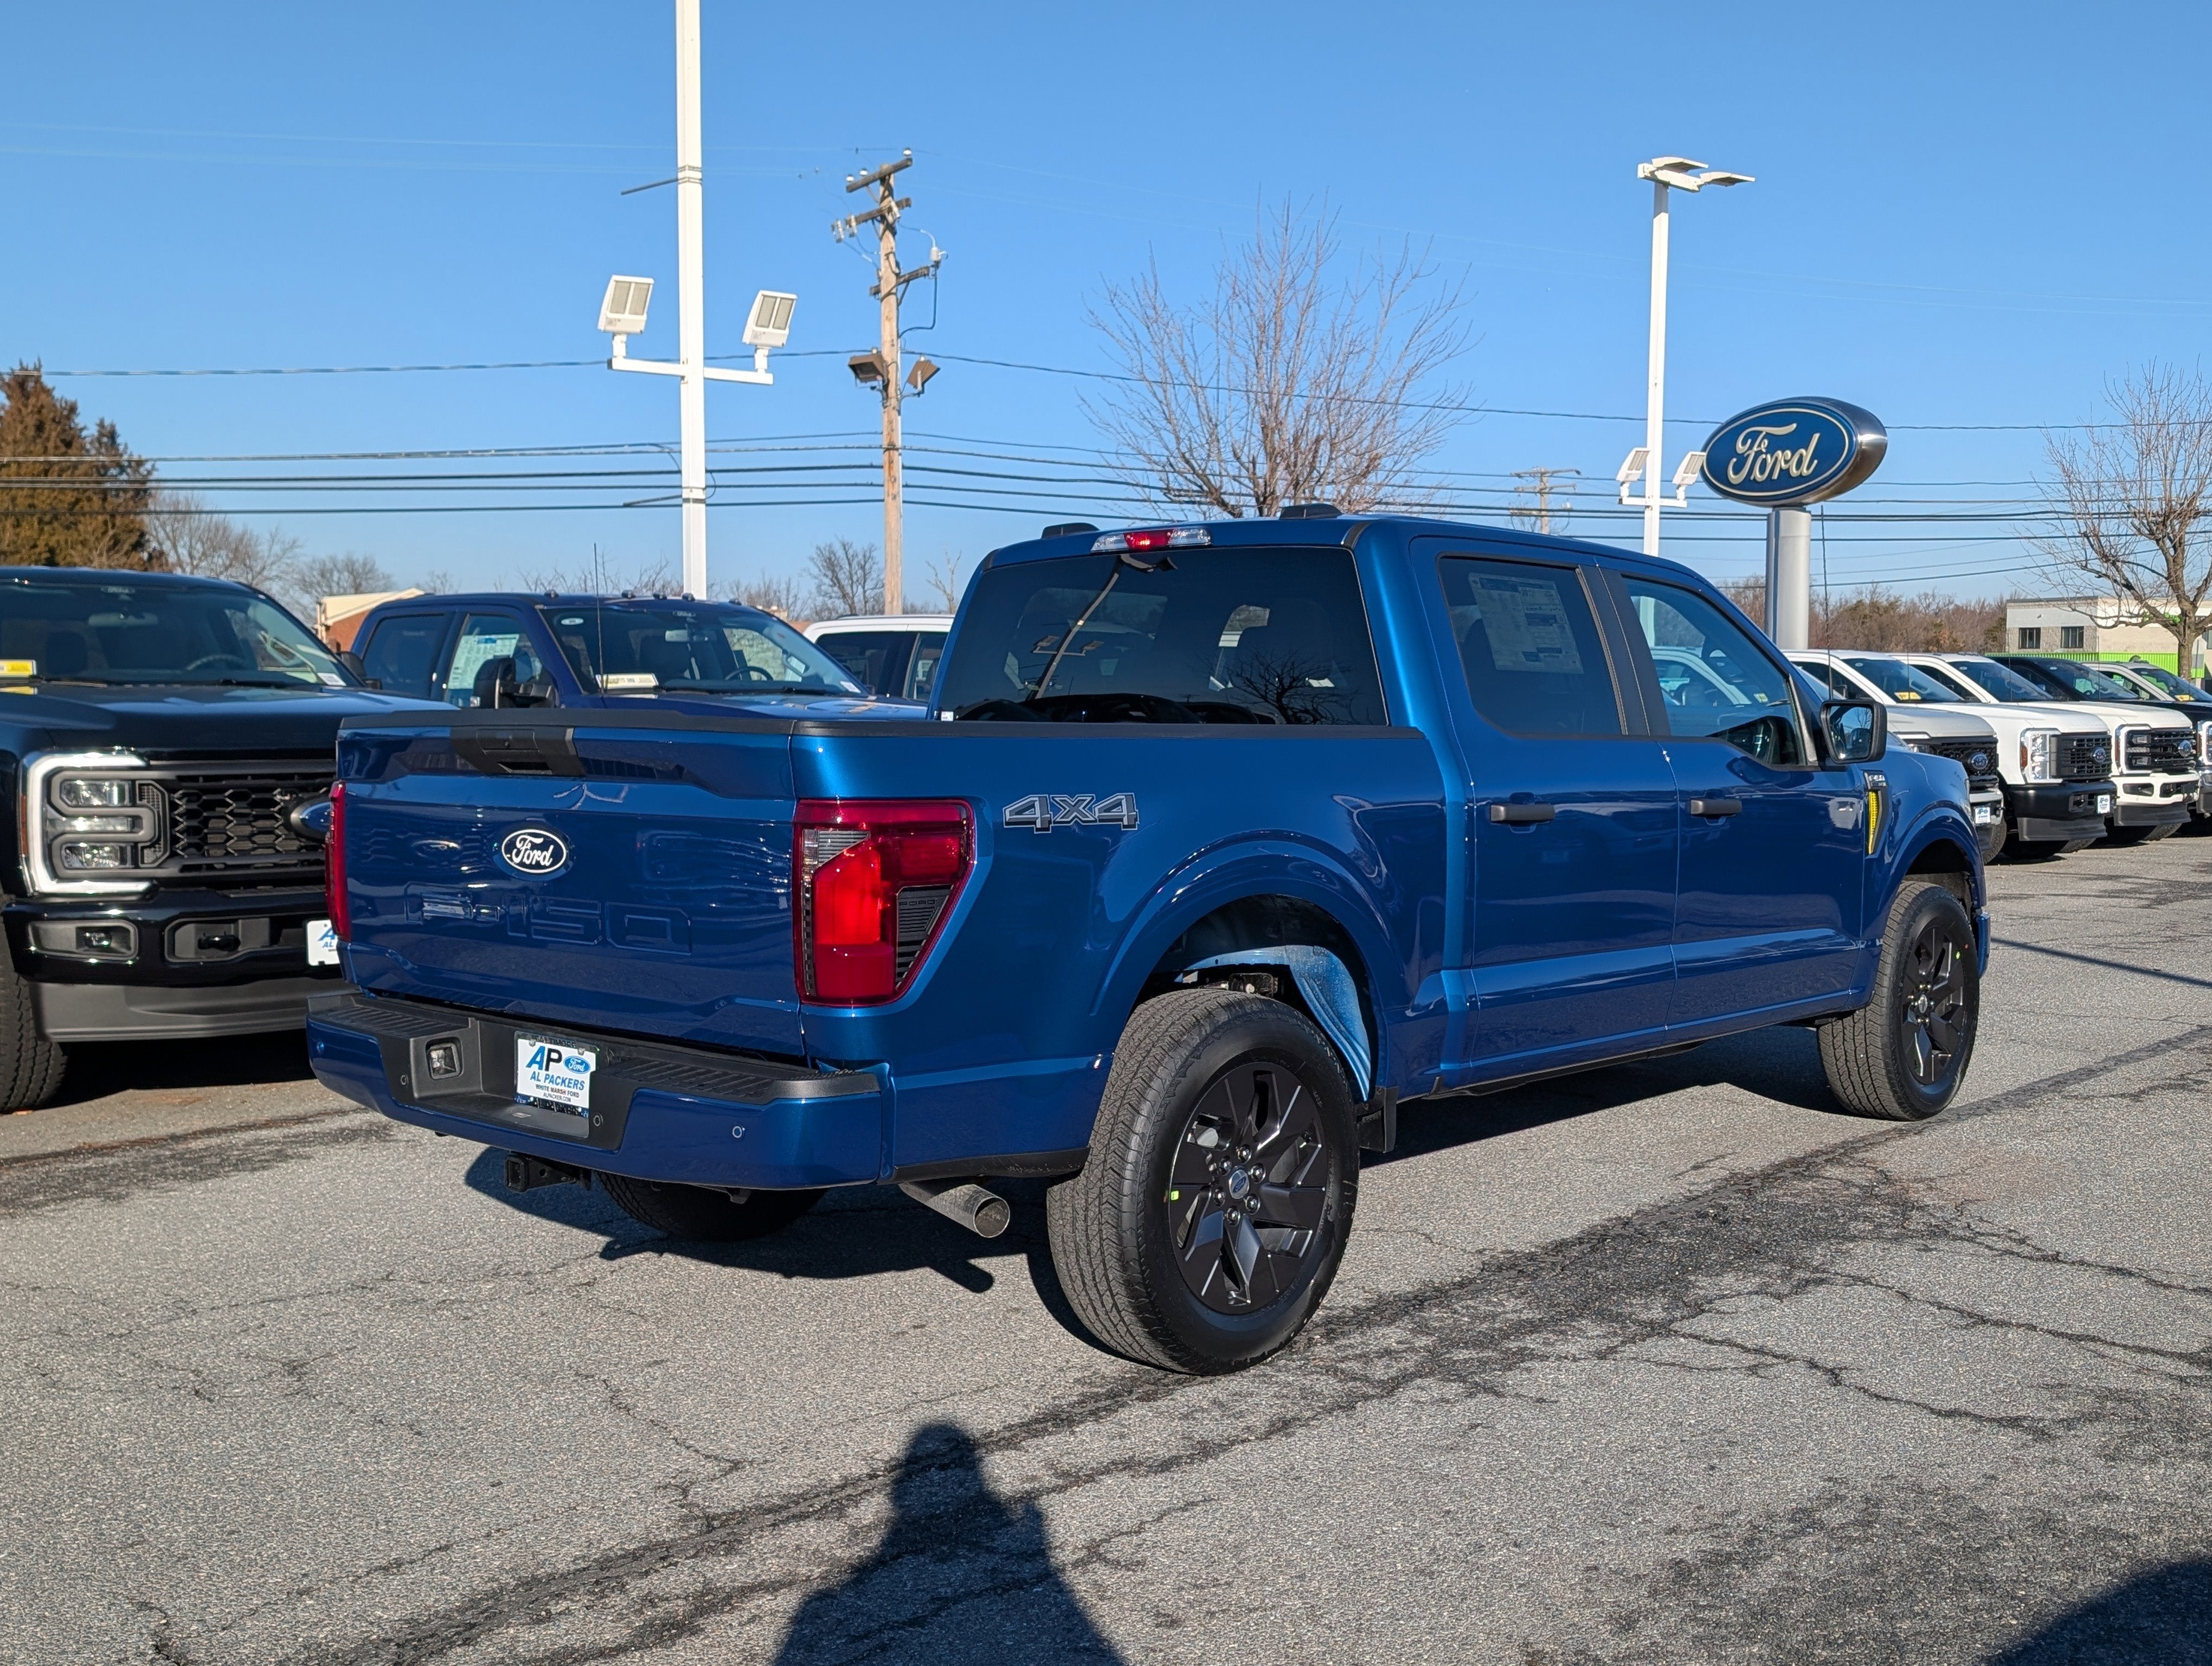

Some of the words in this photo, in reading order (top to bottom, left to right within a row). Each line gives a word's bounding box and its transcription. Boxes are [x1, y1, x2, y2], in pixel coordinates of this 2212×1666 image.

[1727, 422, 1821, 485] Ford
[512, 835, 554, 867] Ford
[525, 1045, 562, 1072] AP
[568, 1057, 586, 1072] Ford
[529, 1071, 542, 1082] AL
[544, 1073, 586, 1091] PACKERS
[535, 1084, 550, 1092] WHITE
[550, 1087, 567, 1096] MARSH
